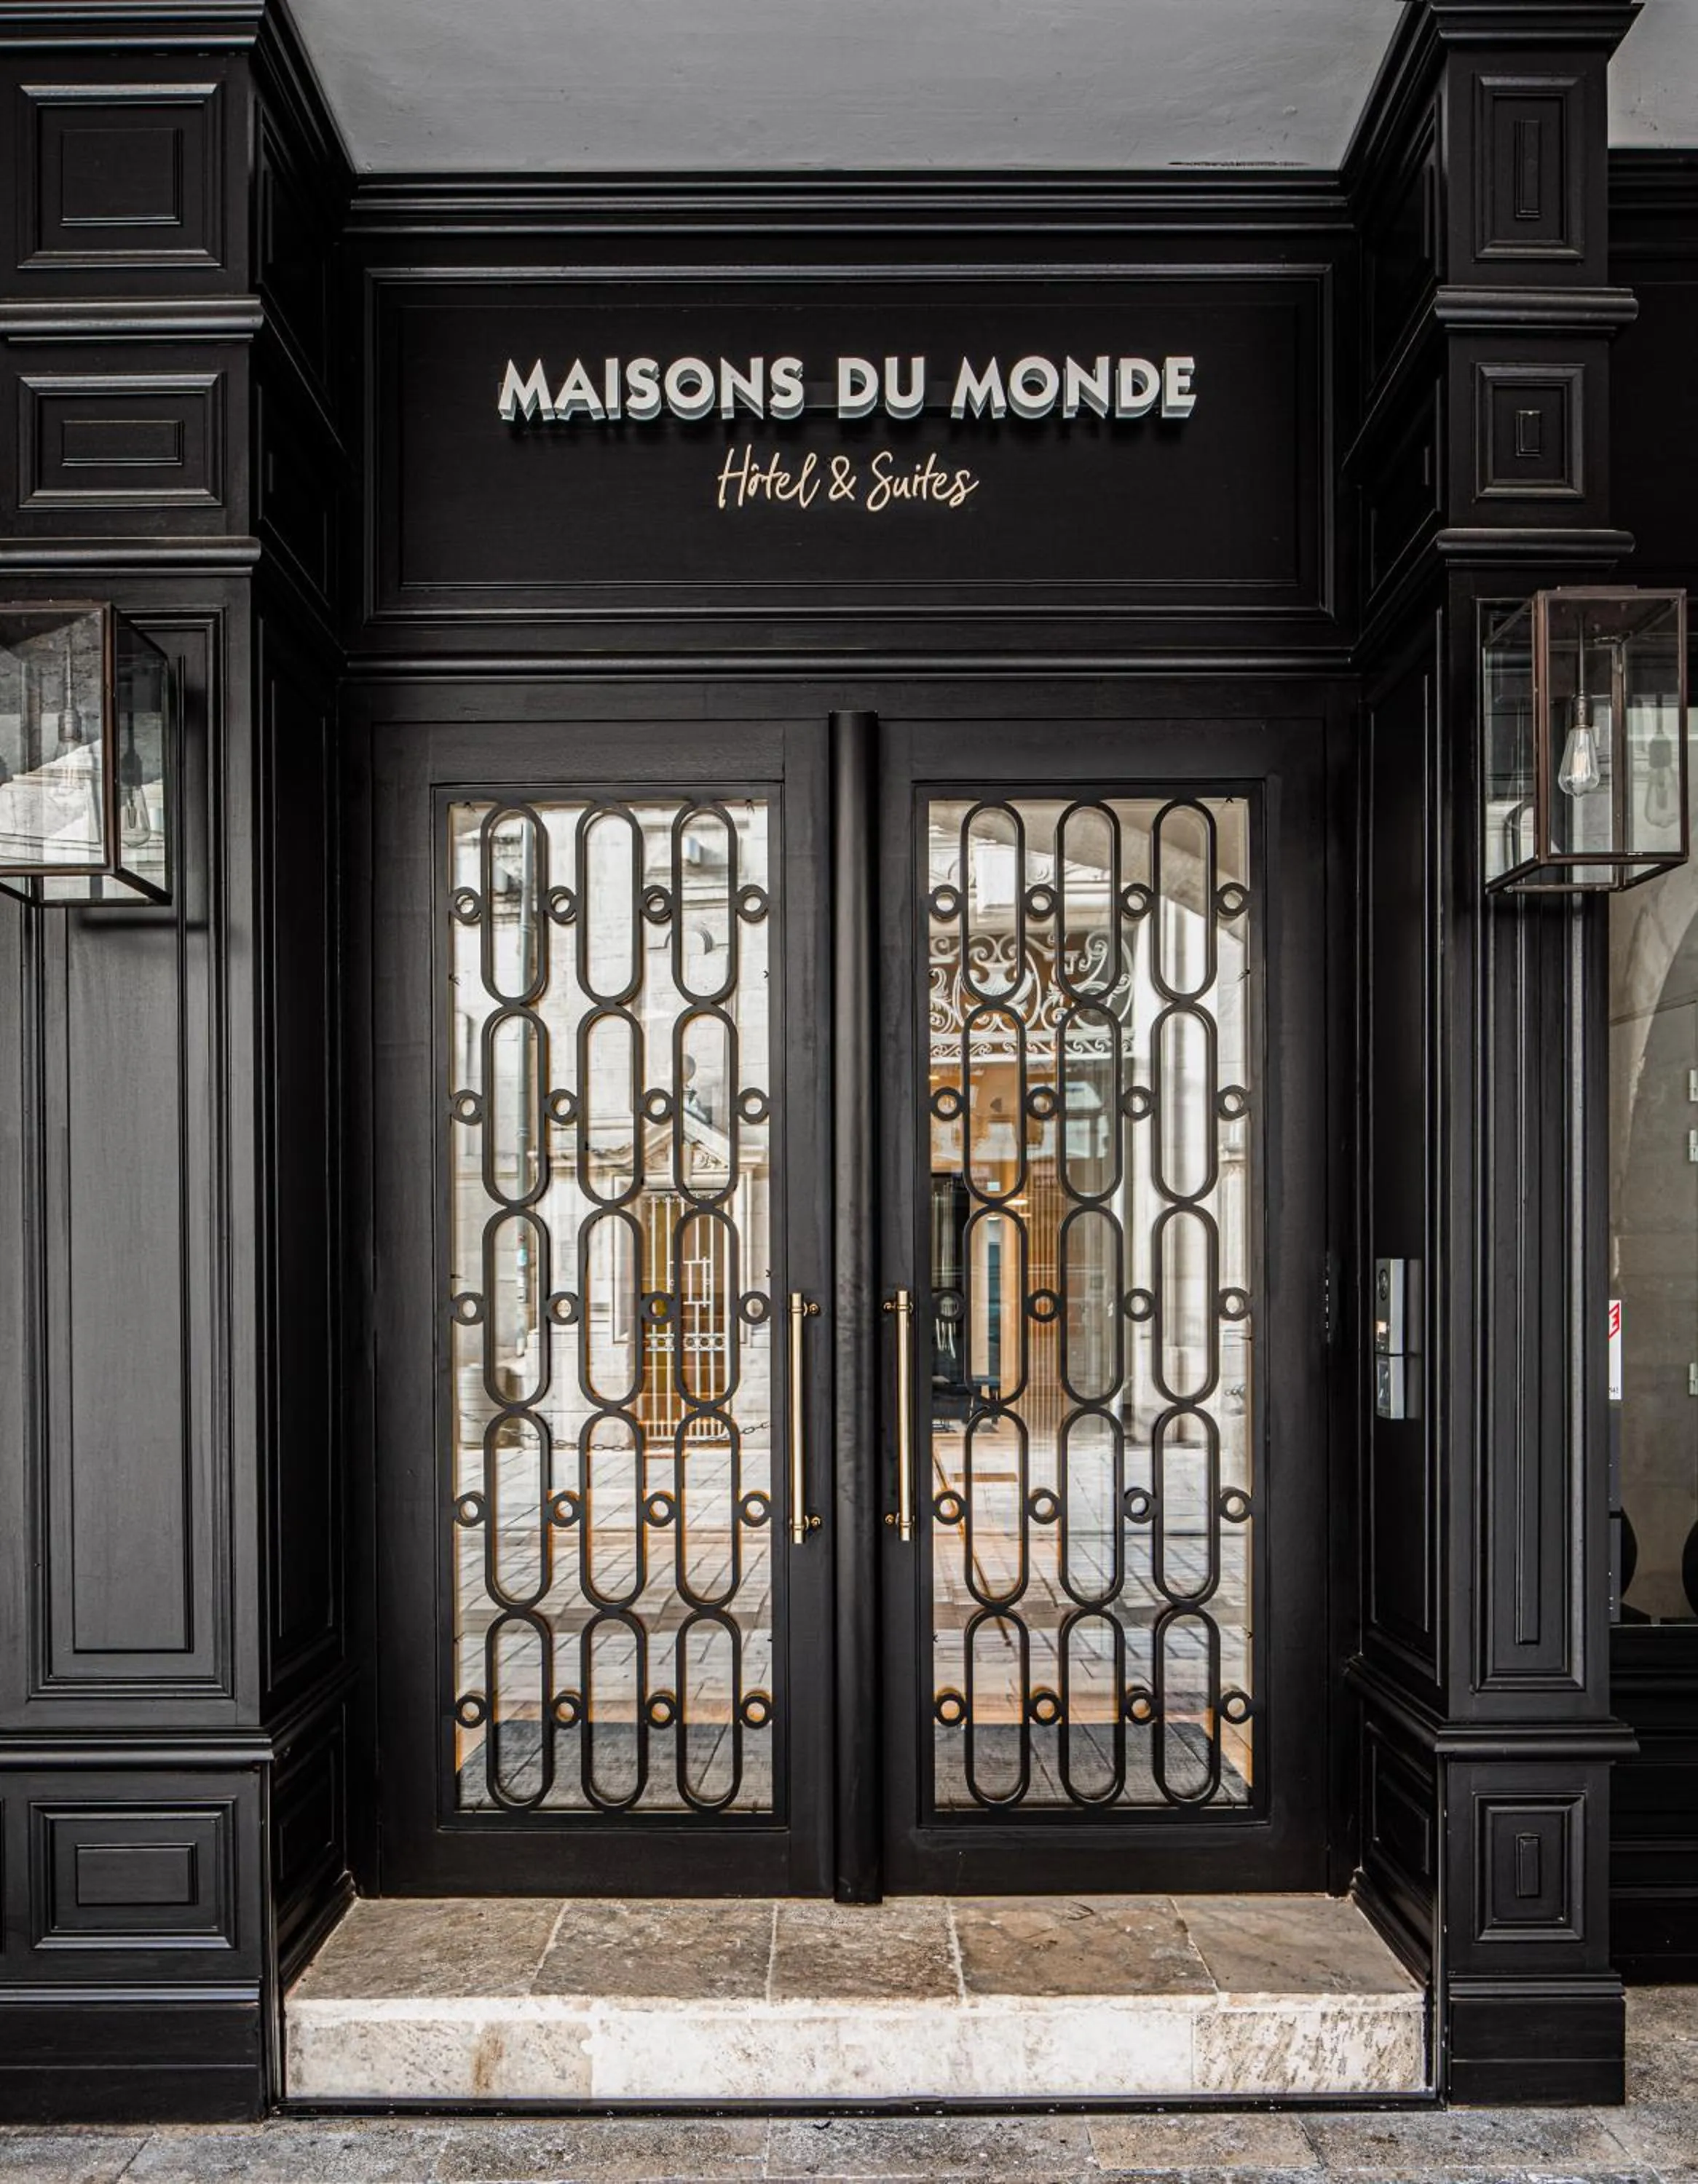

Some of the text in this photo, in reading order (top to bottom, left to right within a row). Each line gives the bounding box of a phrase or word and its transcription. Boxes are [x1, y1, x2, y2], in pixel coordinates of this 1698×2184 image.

[498, 355, 1196, 421] MAISONS DU MONDE
[717, 443, 979, 512] Hôtel & Suites
